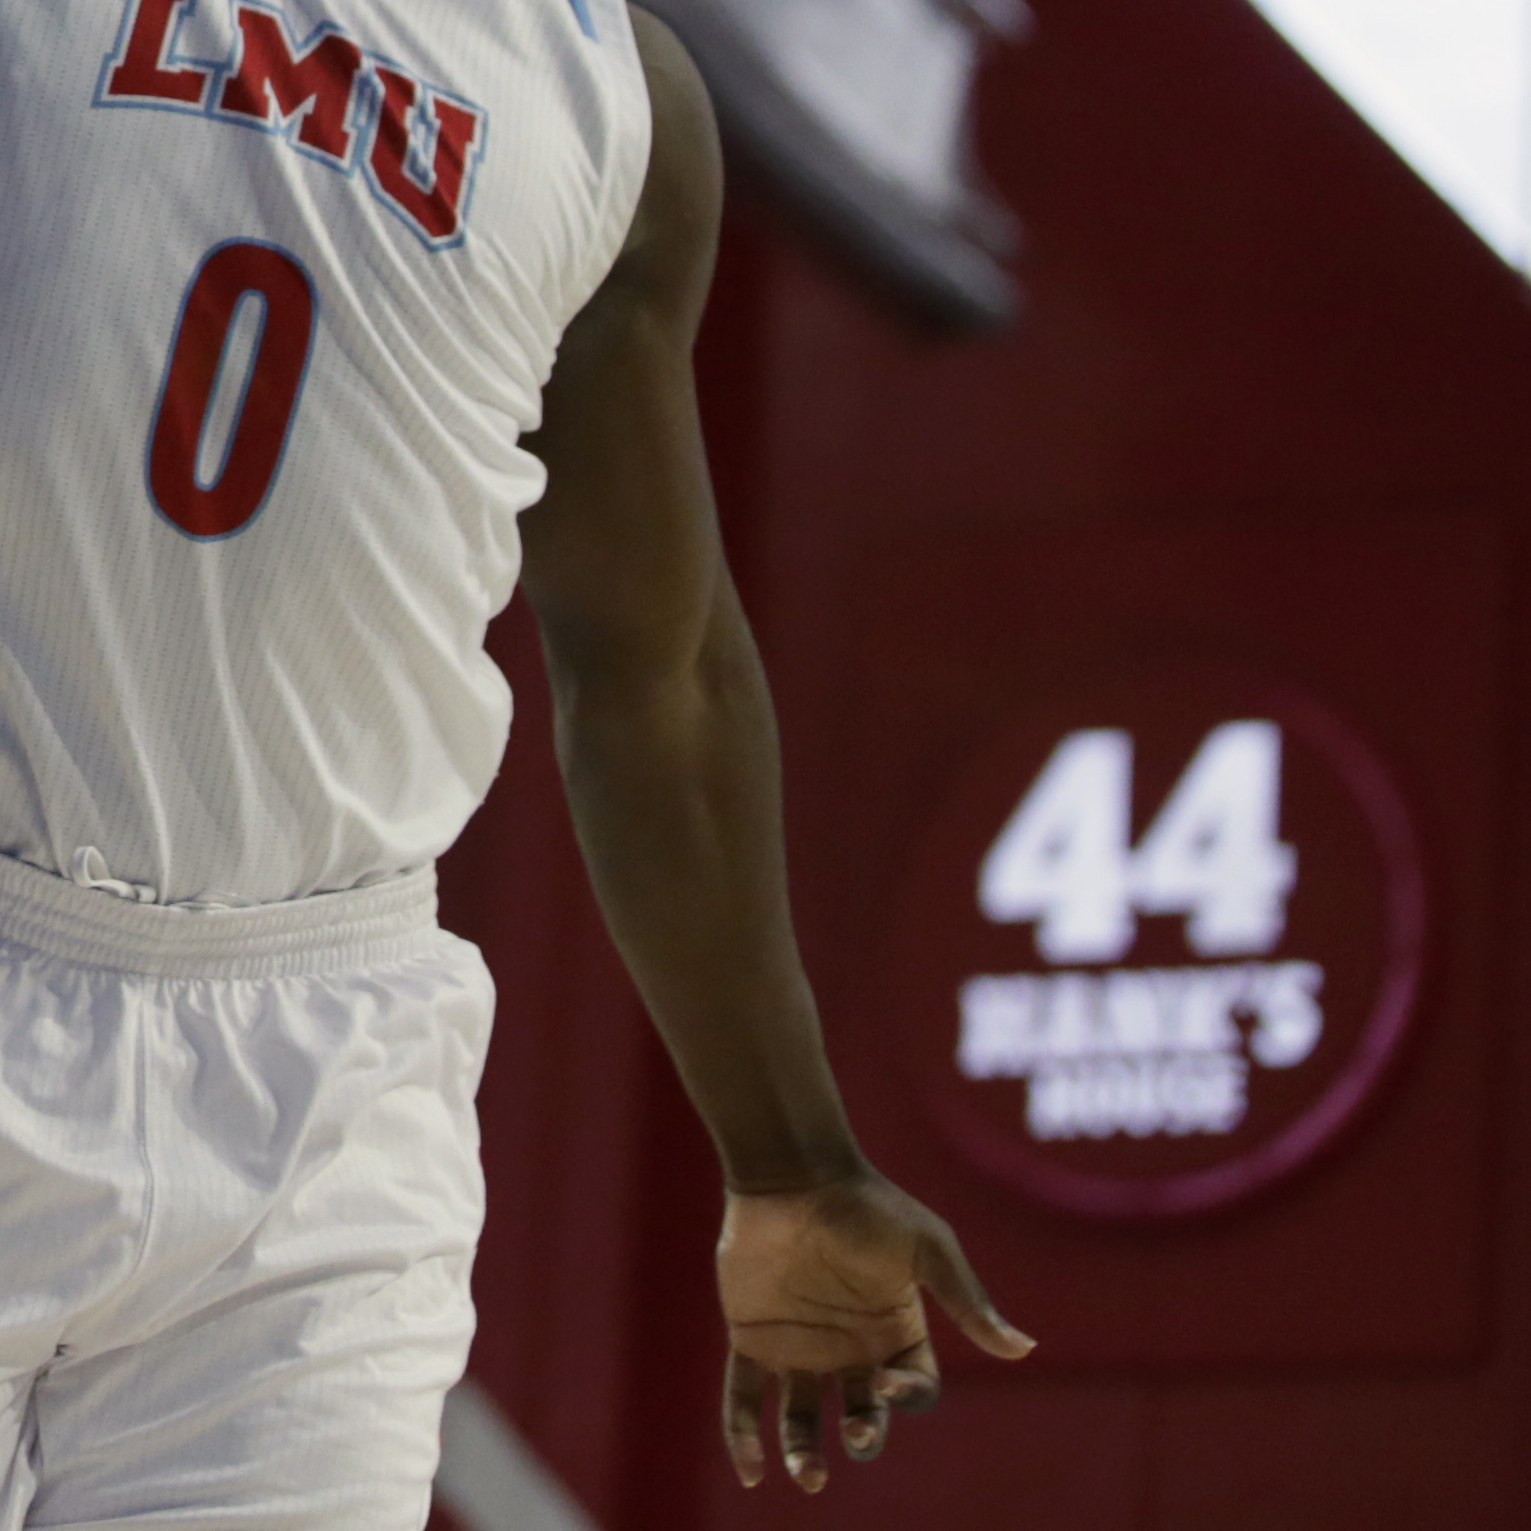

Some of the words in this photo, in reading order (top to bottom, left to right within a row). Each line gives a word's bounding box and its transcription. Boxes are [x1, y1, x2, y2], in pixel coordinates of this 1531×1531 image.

[144, 235, 319, 542] 0
[977, 718, 1298, 964] 44
[957, 960, 1325, 1080] HANK'S
